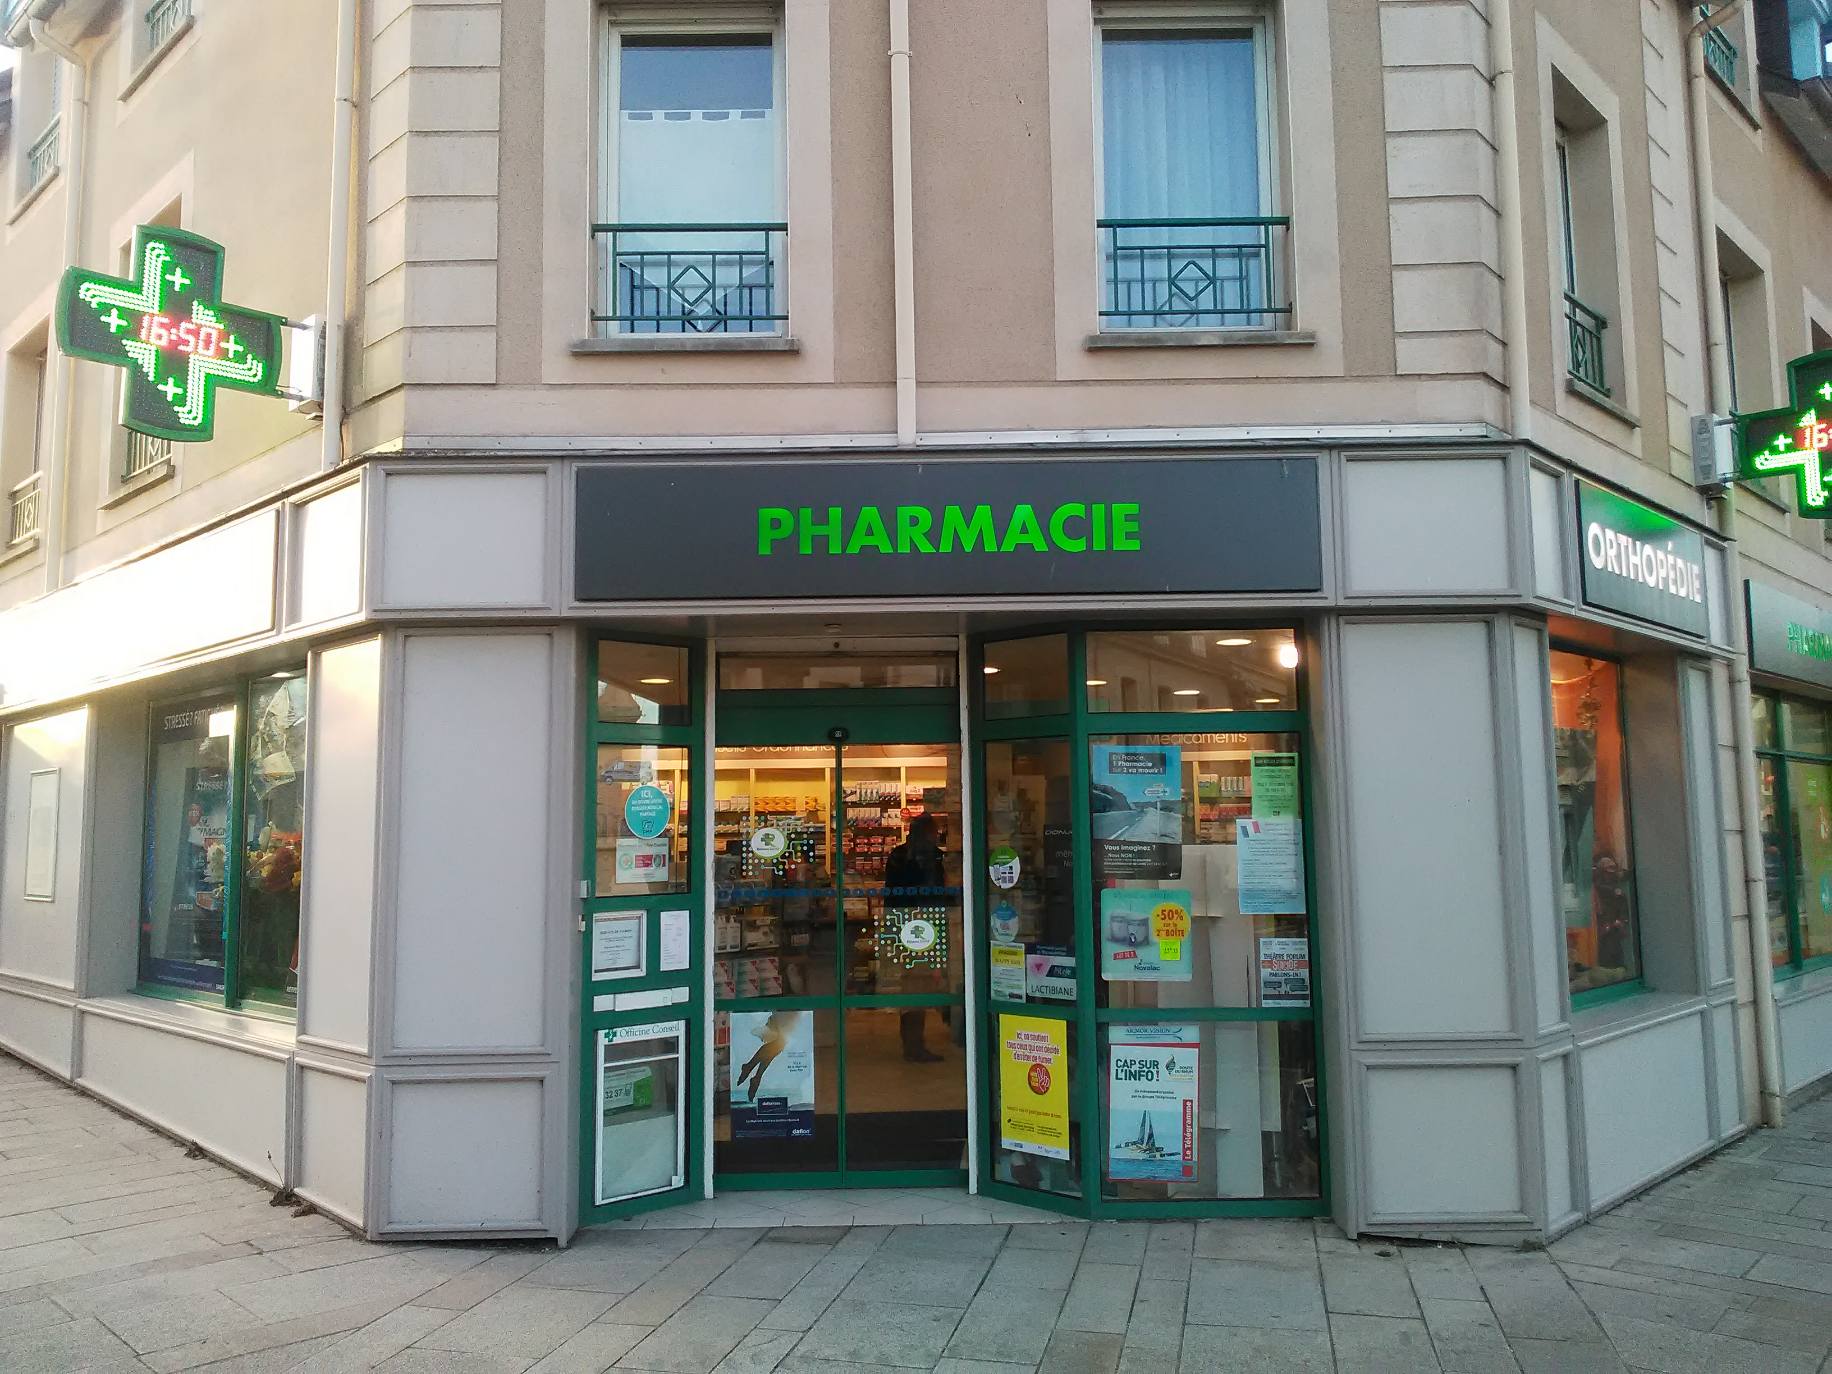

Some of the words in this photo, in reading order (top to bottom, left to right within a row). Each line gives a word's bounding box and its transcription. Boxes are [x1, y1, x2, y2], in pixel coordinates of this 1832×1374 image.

[140, 314, 218, 356] 16:50
[757, 502, 1141, 556] PHARMACIE
[1587, 521, 1702, 603] ORTHOPÉDIE
[1031, 984, 1074, 997] LACTIBIANE
[620, 1026, 651, 1038] Officine
[1115, 1058, 1136, 1069] CAP
[1138, 1059, 1159, 1070] SUR
[1115, 1069, 1155, 1081] L'INFO
[1183, 1101, 1193, 1149] Télégramme
[1185, 1150, 1192, 1160] Le
